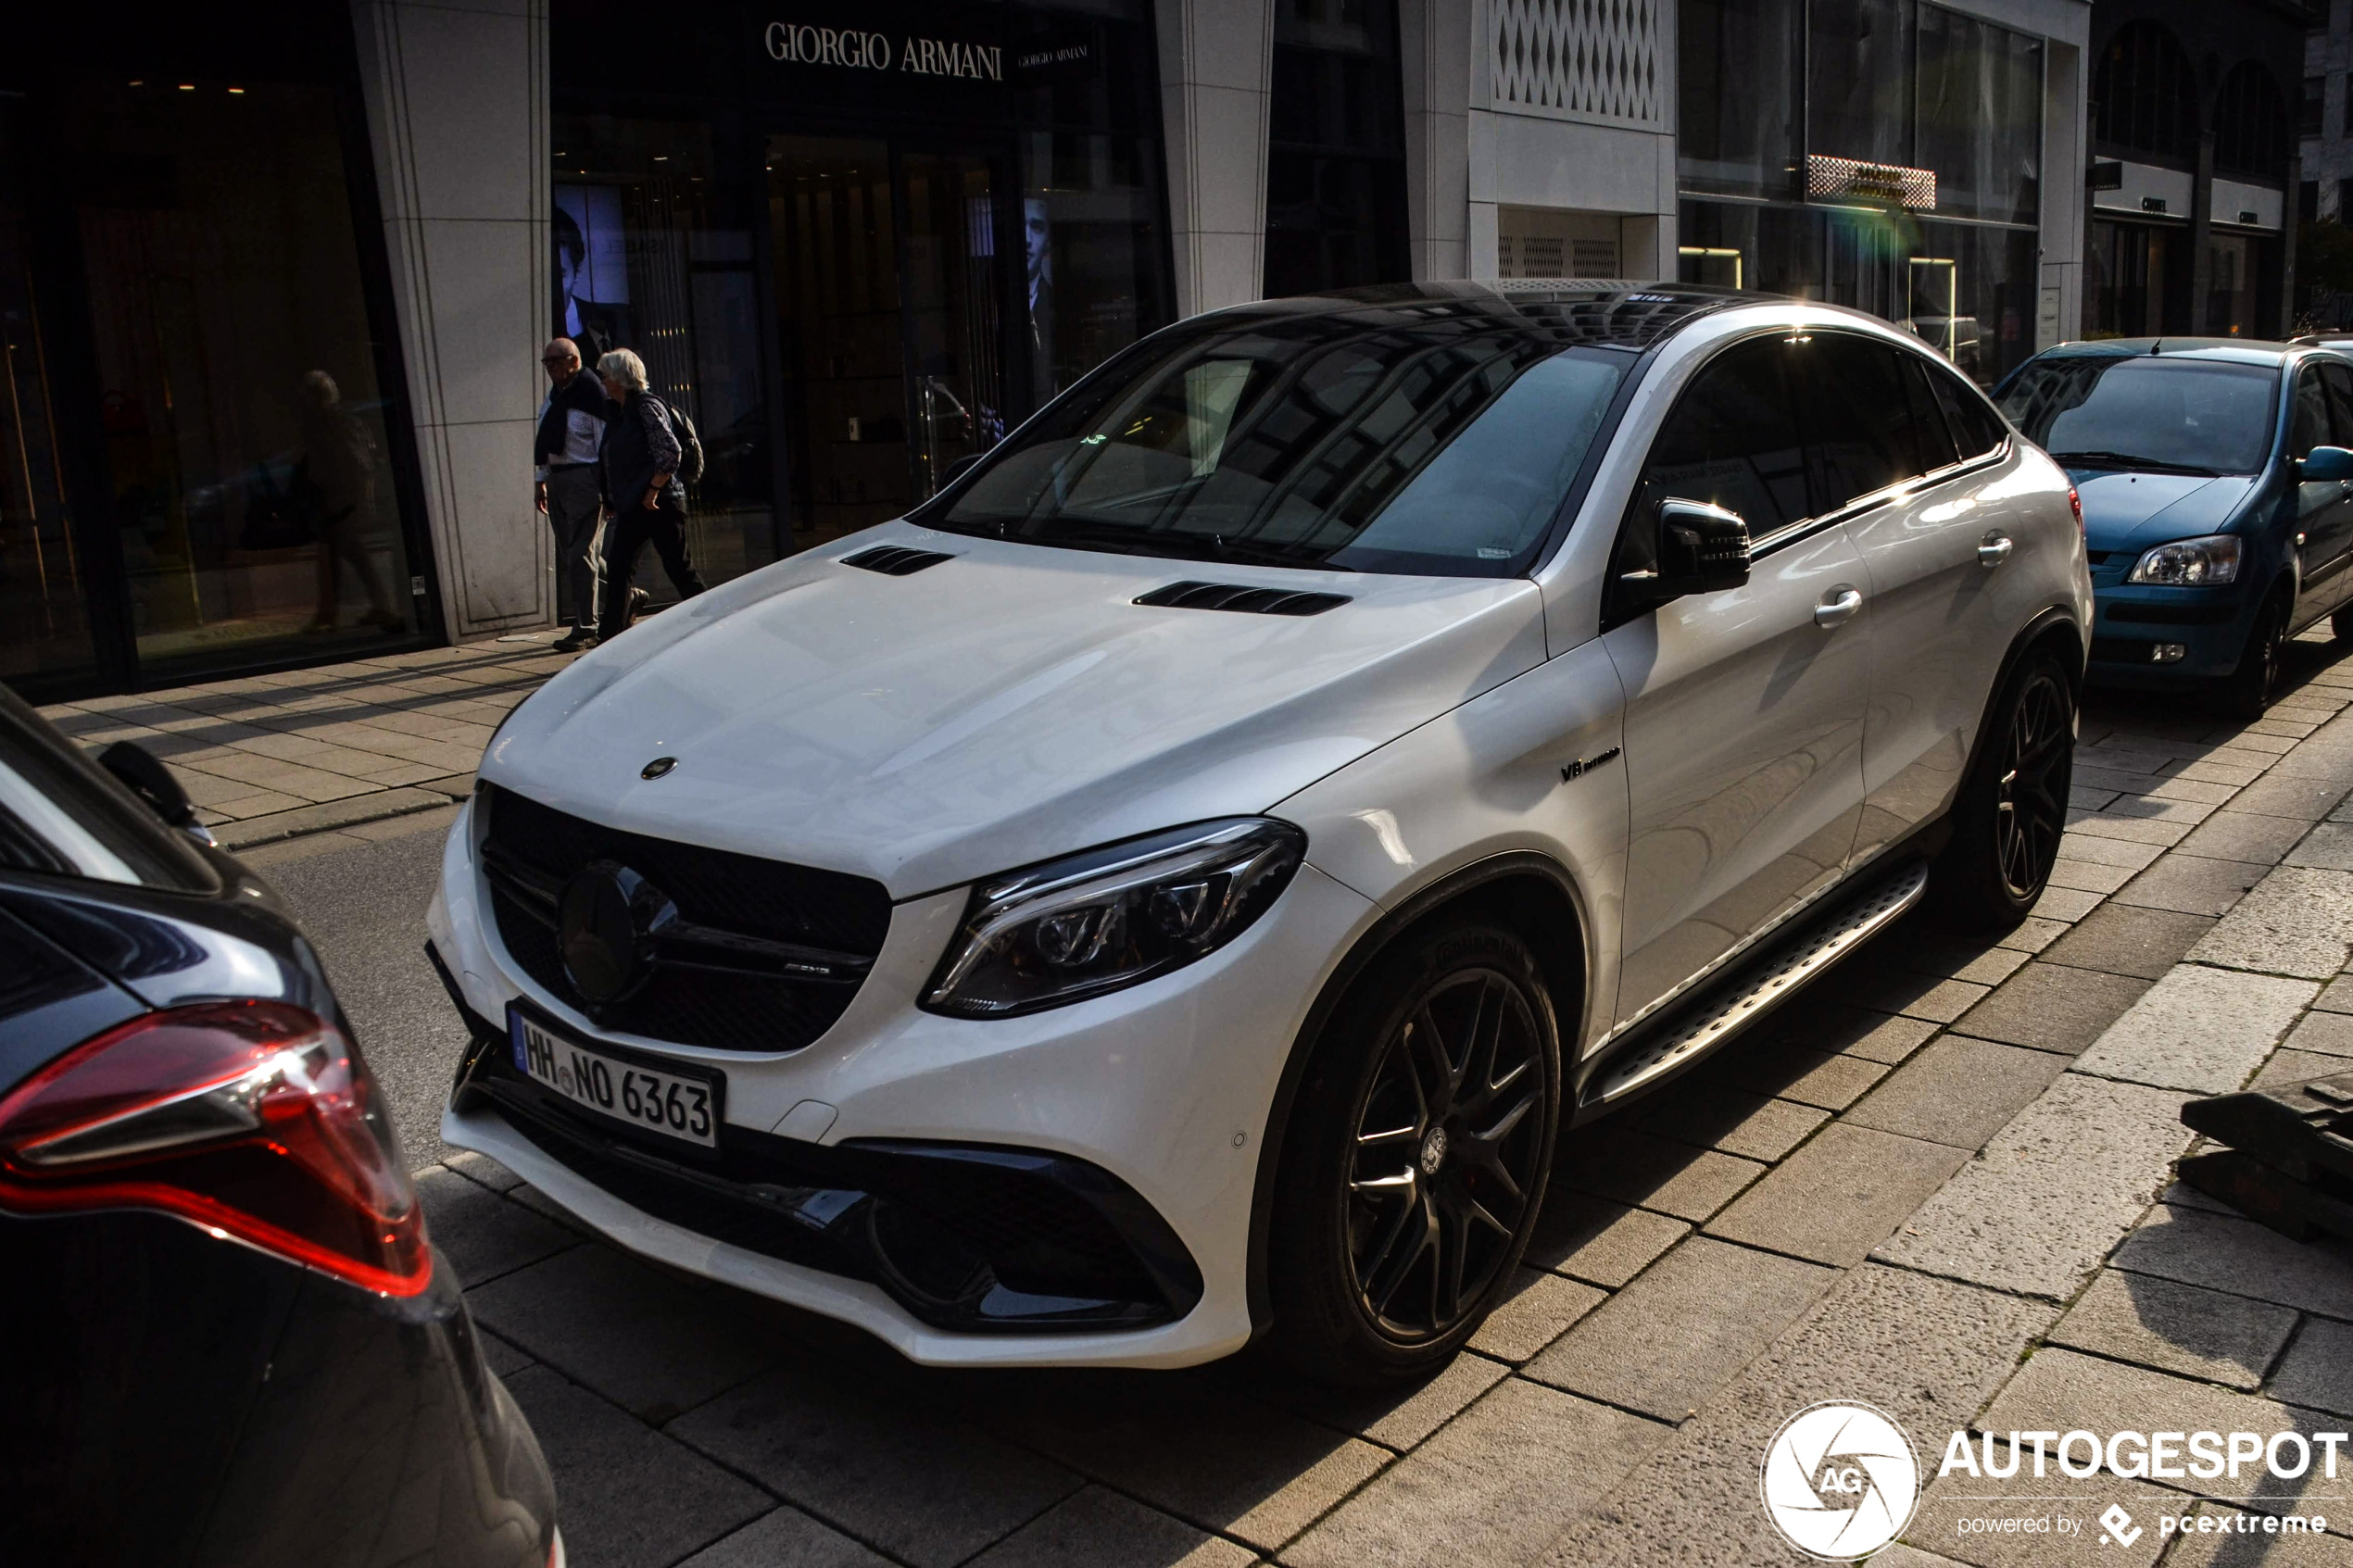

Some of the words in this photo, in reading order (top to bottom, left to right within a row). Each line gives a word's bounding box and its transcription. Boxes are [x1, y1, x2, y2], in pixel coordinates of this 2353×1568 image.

[765, 20, 890, 70] GIORGIO
[900, 34, 1004, 82] ARMANI
[1018, 52, 1053, 68] GIORGIO
[1056, 44, 1088, 62] ARMANI
[1561, 759, 1582, 782] V8
[523, 1024, 559, 1084] HH
[572, 1052, 613, 1109] NO
[622, 1071, 710, 1136] 6363
